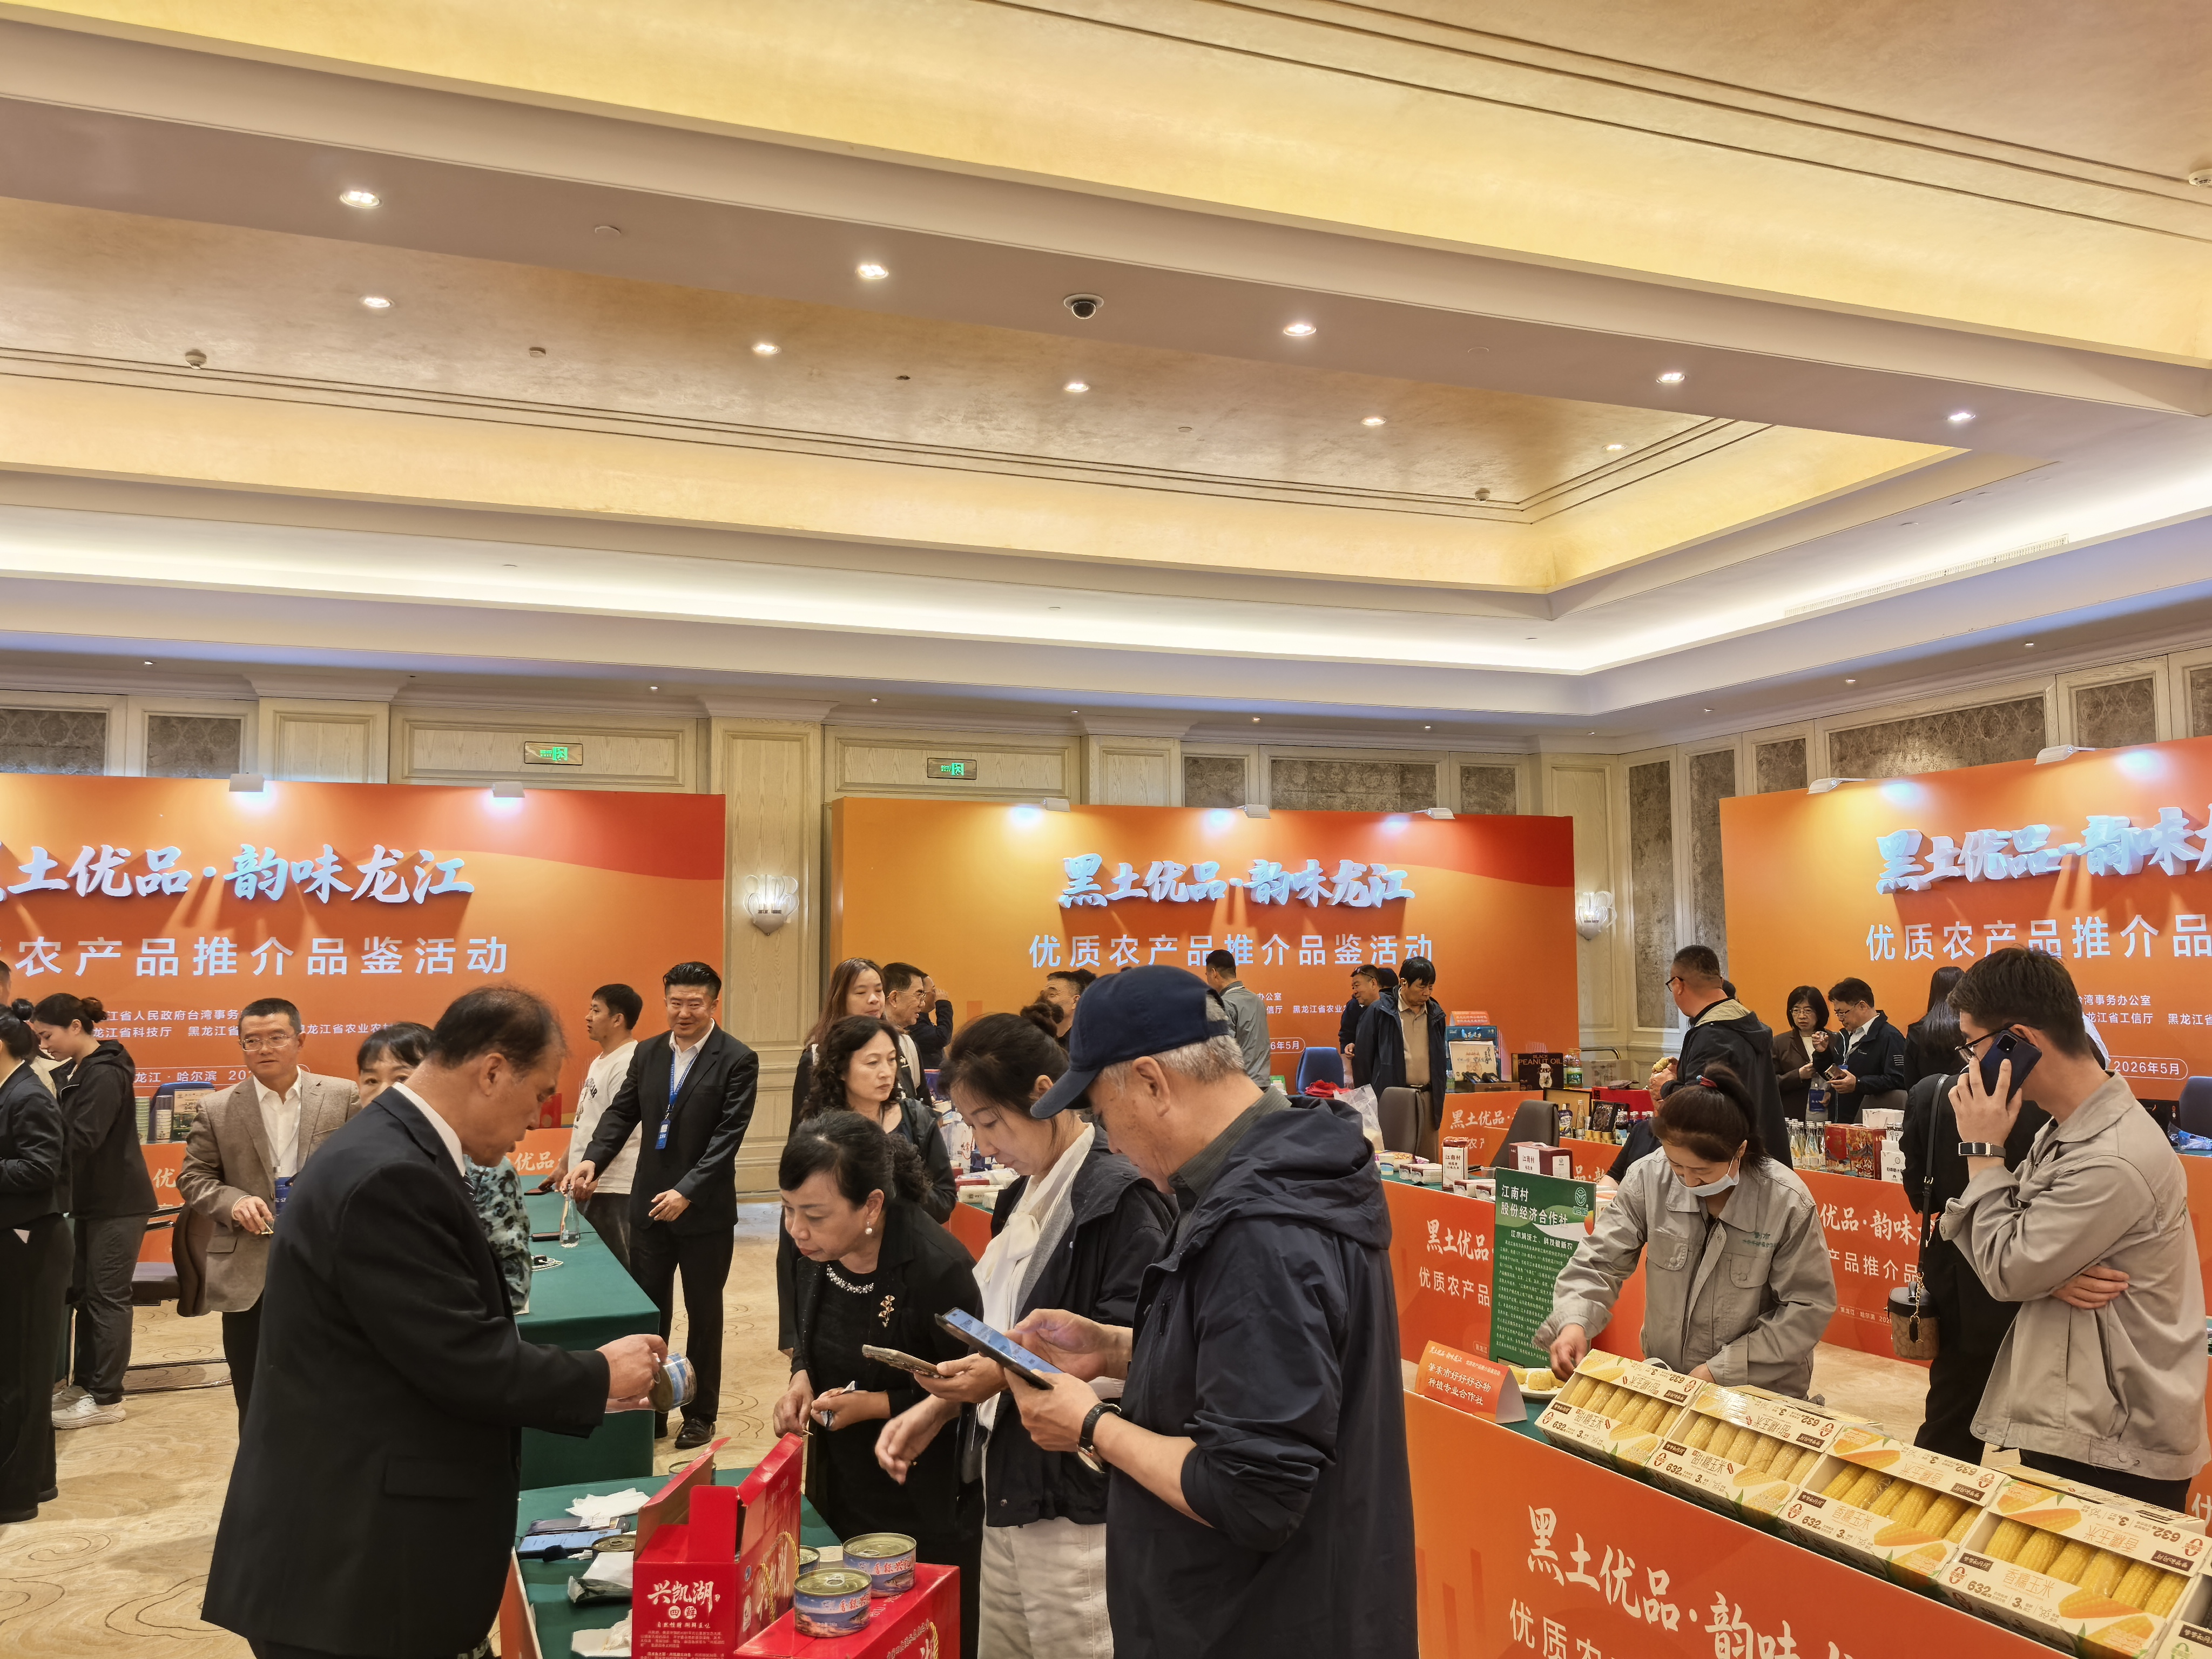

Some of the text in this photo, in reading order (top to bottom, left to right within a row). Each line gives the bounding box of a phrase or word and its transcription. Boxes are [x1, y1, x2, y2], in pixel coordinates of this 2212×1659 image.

[0, 841, 474, 904] 土优品·韵味龙江
[1058, 853, 1415, 908] 黑土优品·韵味龙江
[0, 936, 507, 976] 农产品推介品鉴活动
[107, 1009, 244, 1021] 江省人民政府台湾事务
[2114, 1061, 2180, 1075] 2026年5月
[1450, 1109, 1518, 1130] 黑土优品·
[1502, 1184, 1529, 1202] 江南村
[1501, 1202, 1568, 1226] 股份经济合作社
[1419, 1266, 1490, 1307] 优质农产品
[1428, 1362, 1492, 1392] 肇东市好好好谷物
[1428, 1377, 1483, 1405] 种植专业合作社
[2083, 1525, 2140, 1553] 香糯玉米
[1528, 1505, 1851, 1659] 黑土优品·韵味
[2003, 1568, 2055, 1599] 香糯玉米
[648, 1580, 714, 1617] 兴凯湖
